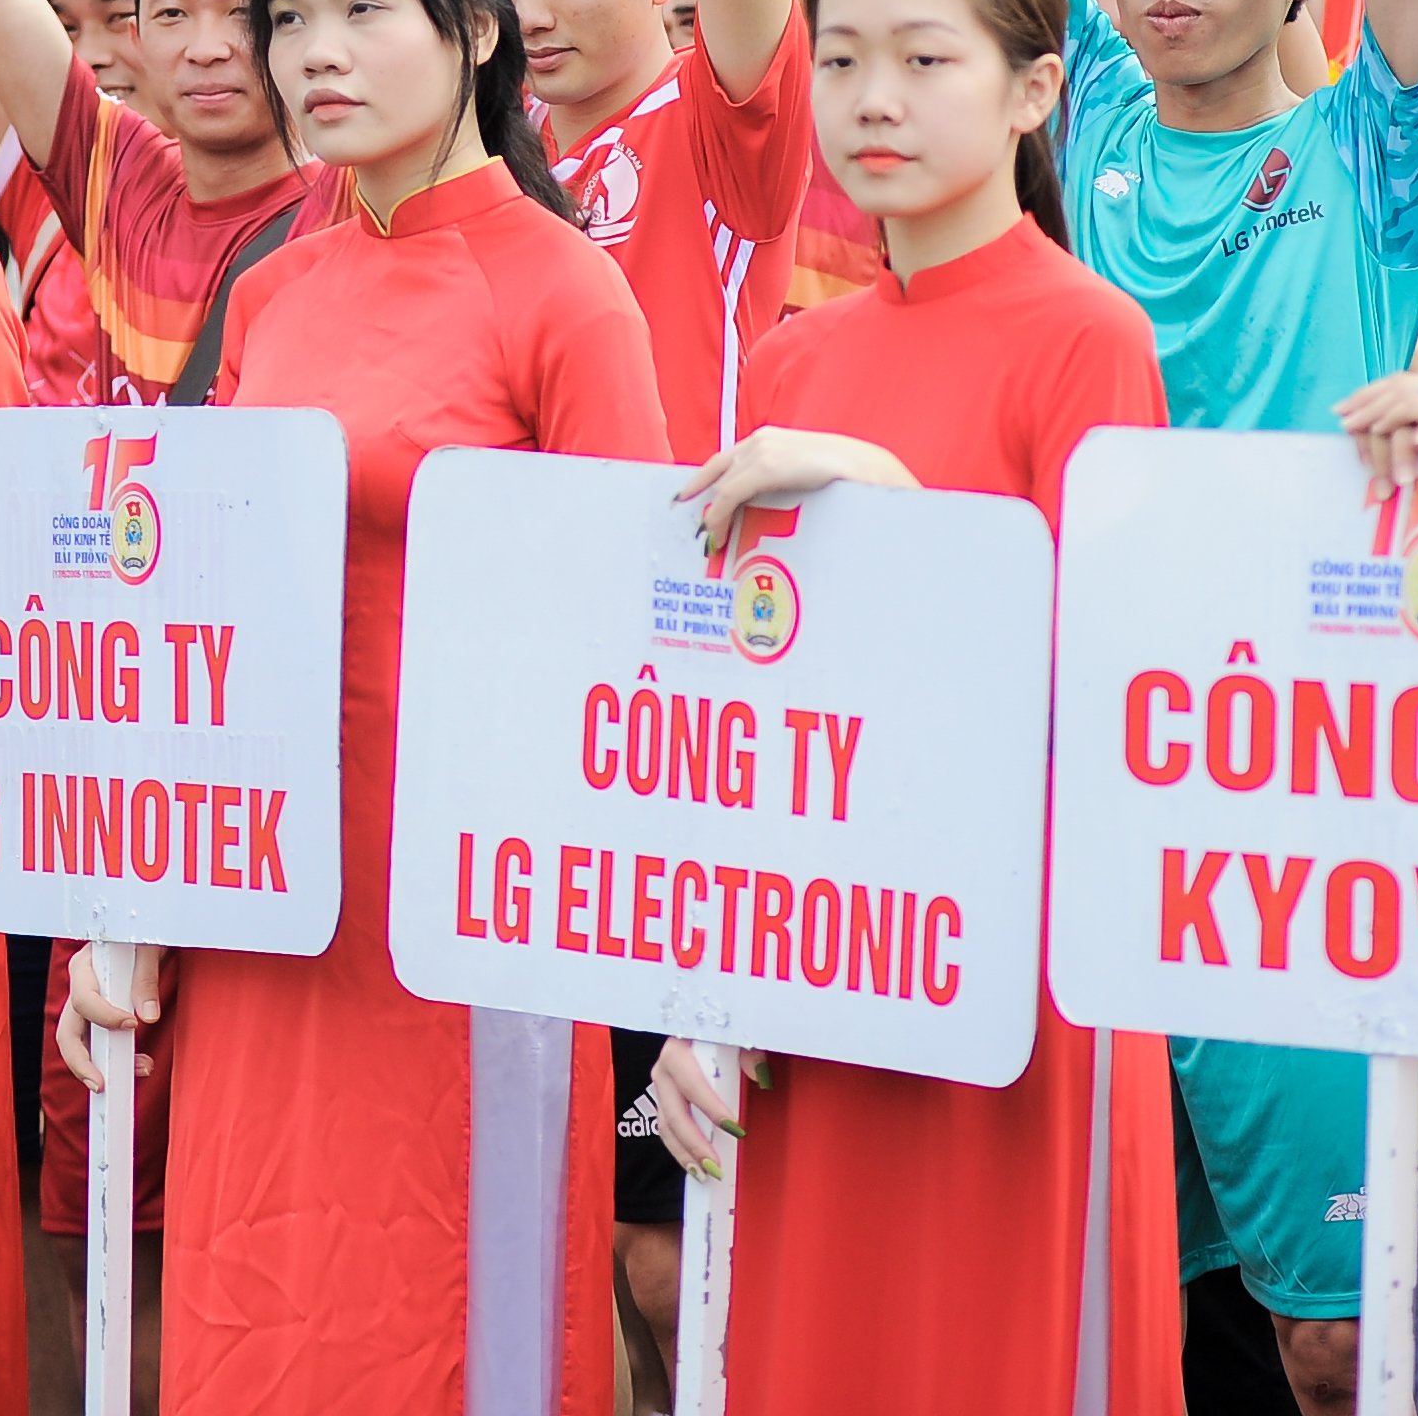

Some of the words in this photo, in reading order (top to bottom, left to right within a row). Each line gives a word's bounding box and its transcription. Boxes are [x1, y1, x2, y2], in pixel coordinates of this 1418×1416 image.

[1220, 230, 1250, 258] LG
[52, 533, 72, 546] KHU
[74, 533, 97, 546] KINH
[165, 623, 234, 727] TY
[582, 664, 757, 809] CÔNG
[784, 708, 862, 821] TY
[22, 772, 288, 893] INNOTEK
[456, 832, 533, 944] LG
[556, 845, 962, 1006] ELECTRONIC
